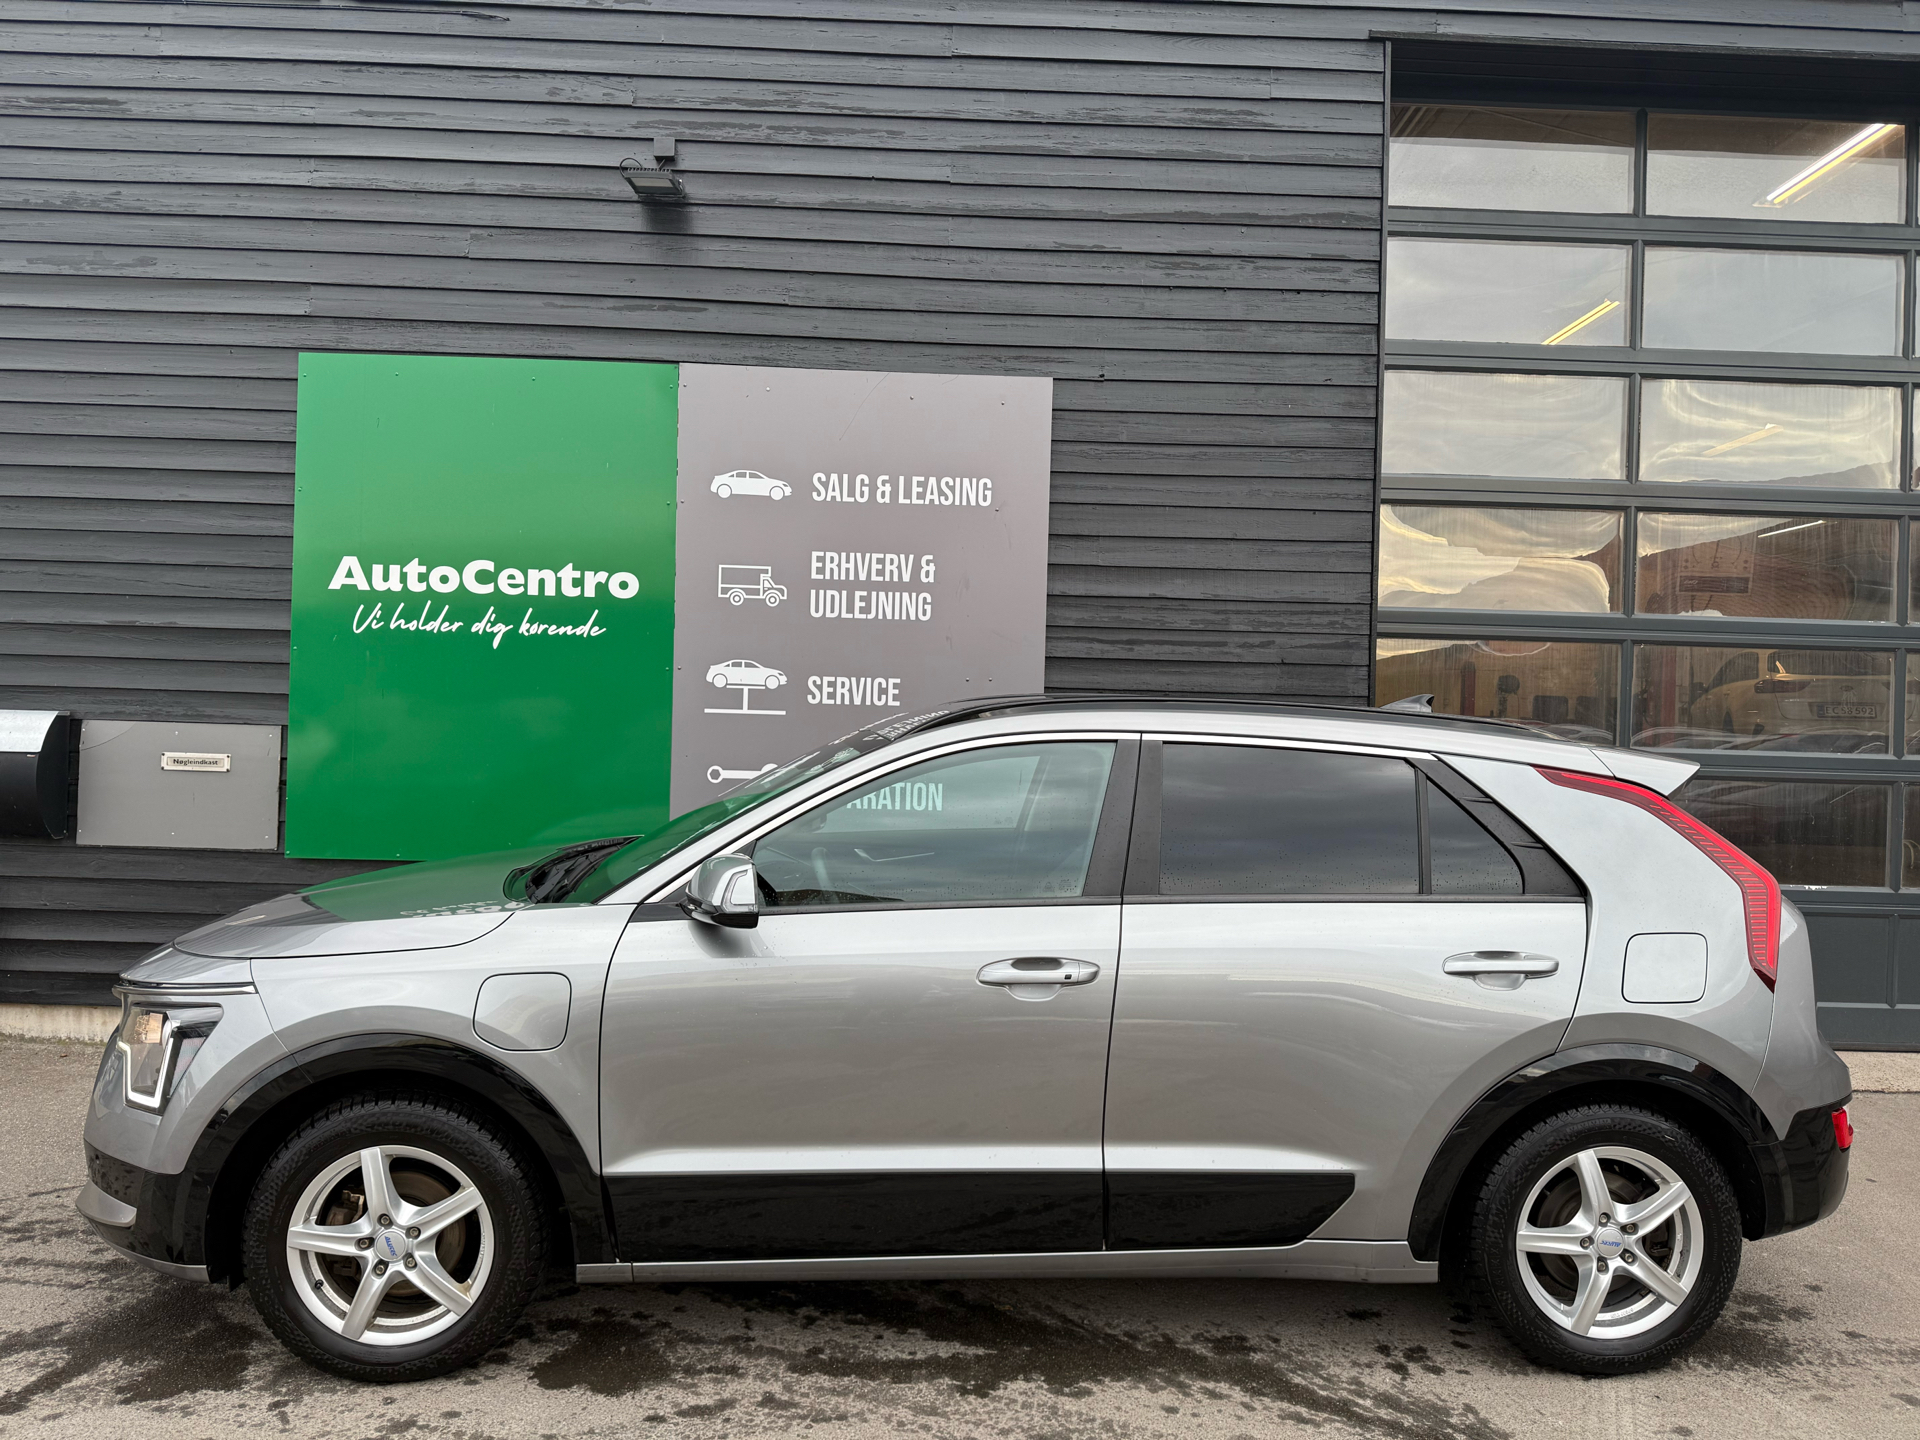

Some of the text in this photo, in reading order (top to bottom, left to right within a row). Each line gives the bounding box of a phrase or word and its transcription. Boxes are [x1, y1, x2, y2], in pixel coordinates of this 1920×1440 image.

[811, 472, 993, 507] SALG & LEASING
[327, 555, 640, 600] AutoCentro
[810, 550, 936, 584] ERHVERV &
[809, 589, 932, 622] UDLEJNING
[352, 600, 607, 650] Vi holder dig kørende
[807, 675, 901, 707] SERVICE
[173, 758, 218, 766] Nøgleindkast
